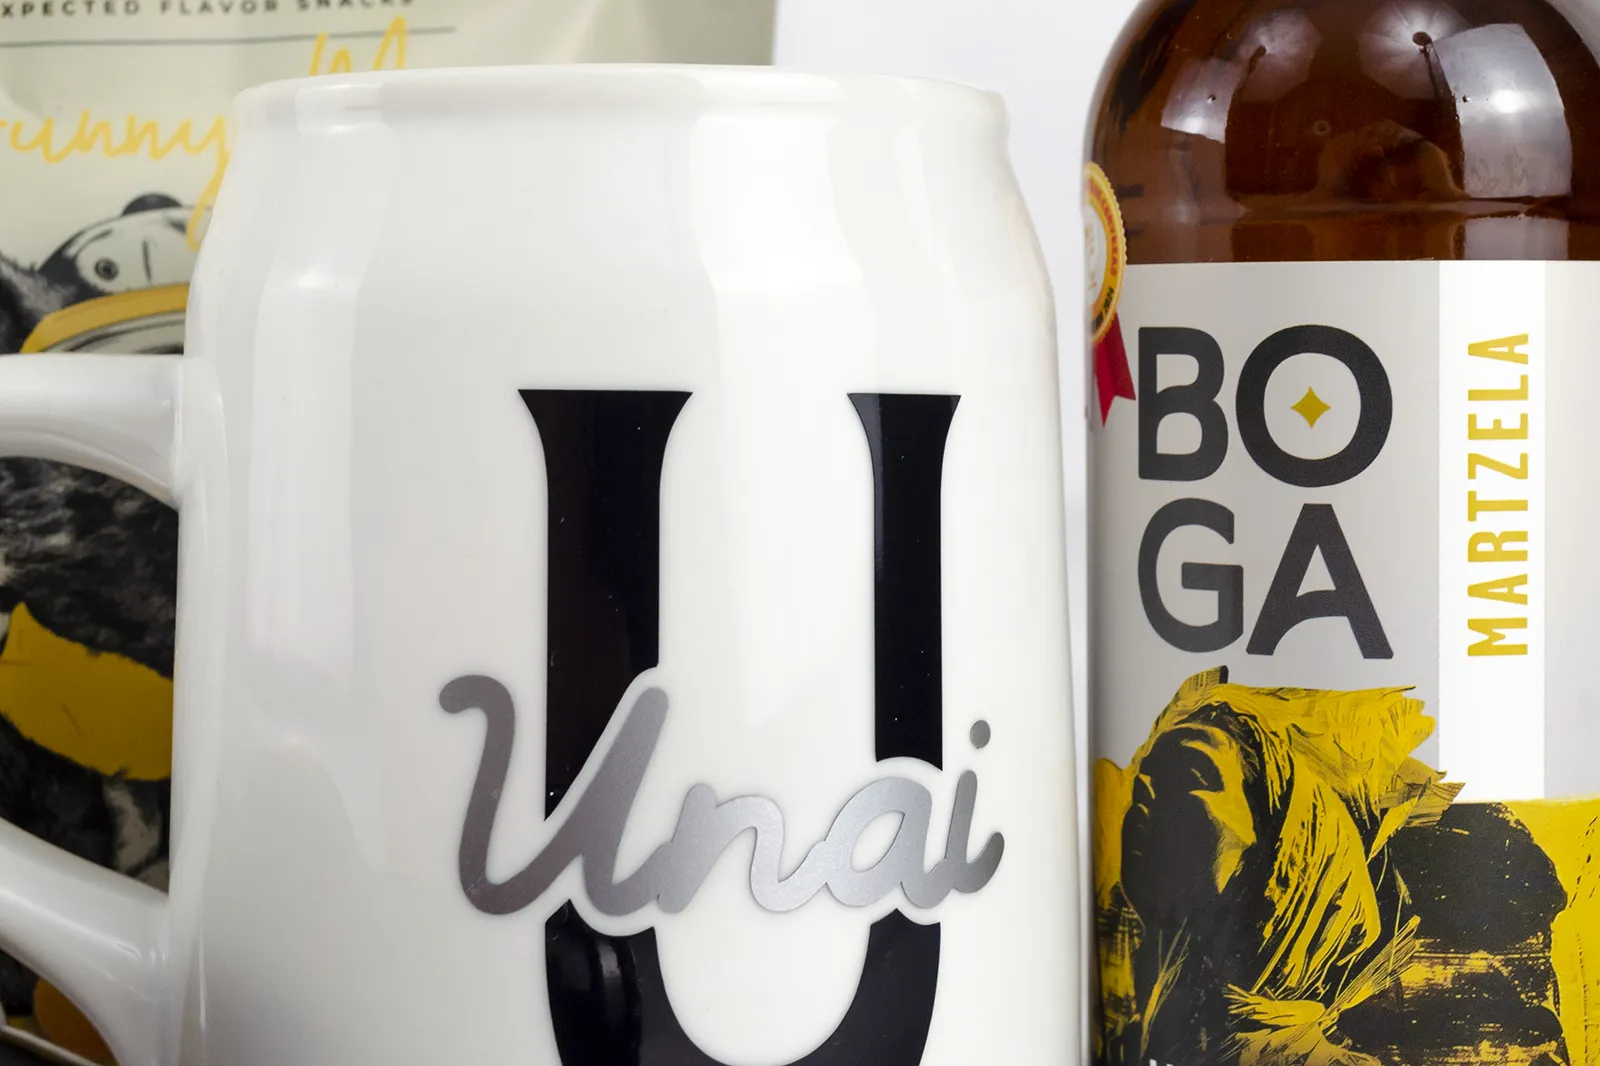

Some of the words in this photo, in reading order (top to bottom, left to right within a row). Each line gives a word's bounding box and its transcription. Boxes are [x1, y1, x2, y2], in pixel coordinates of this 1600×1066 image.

[159, 0, 279, 16] FLAVOR
[0, 109, 233, 252] unny
[1138, 324, 1393, 488] BO
[1467, 333, 1529, 657] MARTZELA
[1138, 498, 1394, 660] GA
[439, 674, 1005, 916] Unai
[517, 389, 962, 1066] U
